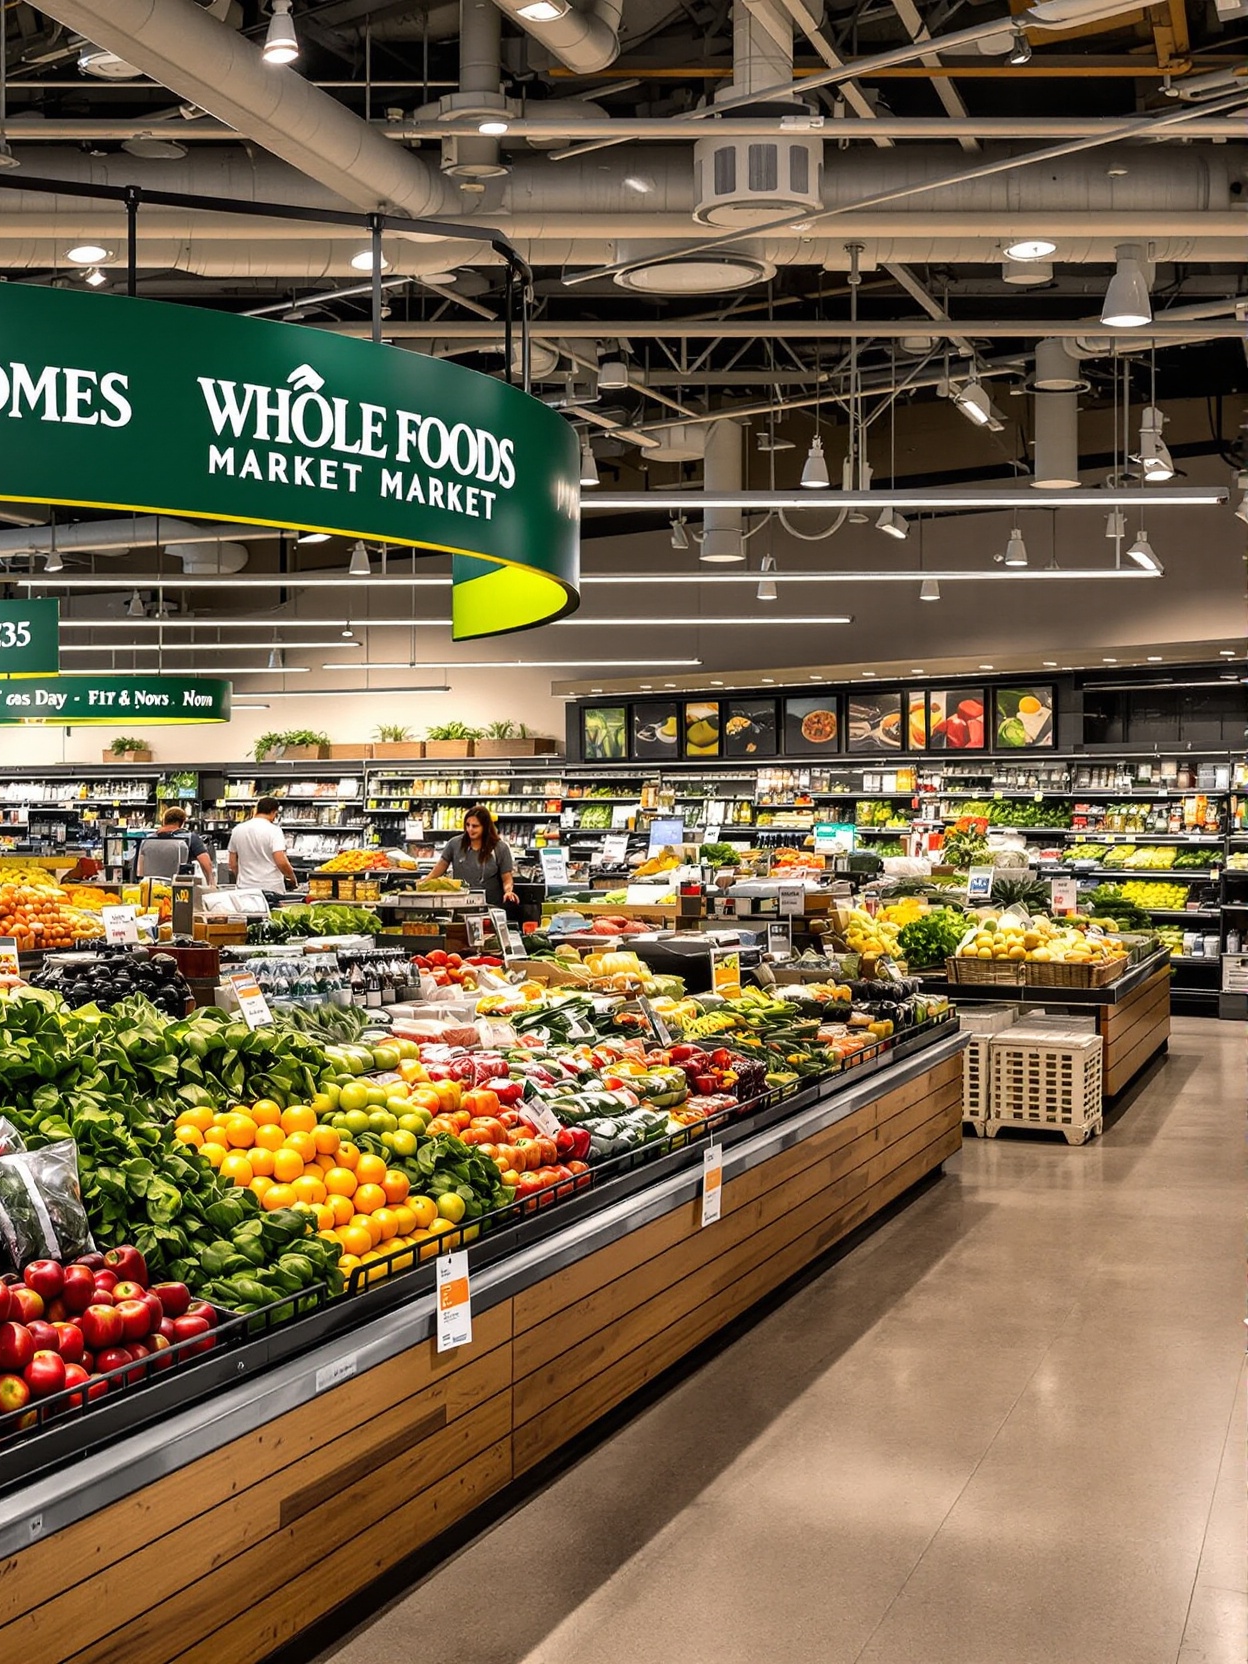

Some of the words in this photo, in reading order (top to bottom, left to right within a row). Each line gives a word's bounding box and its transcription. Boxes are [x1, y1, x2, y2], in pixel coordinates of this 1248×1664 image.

[197, 376, 389, 459] WHOLE
[395, 409, 516, 490] FOODS
[208, 444, 363, 493] MARKET
[380, 467, 497, 520] MARKET
[35, 689, 68, 710] Day
[118, 690, 131, 706] &
